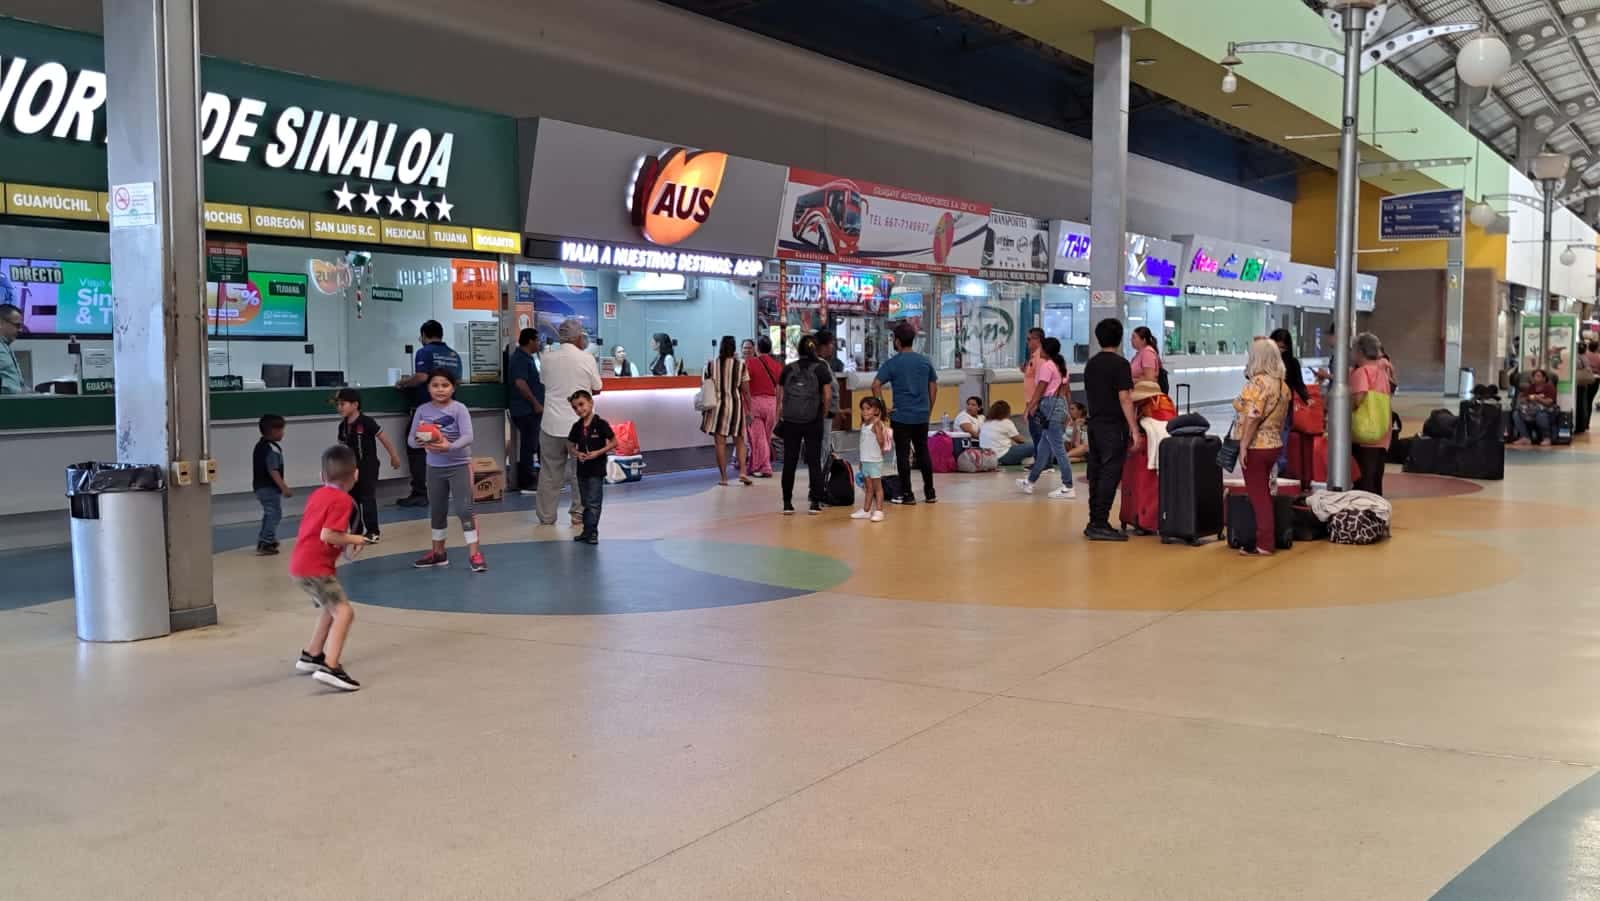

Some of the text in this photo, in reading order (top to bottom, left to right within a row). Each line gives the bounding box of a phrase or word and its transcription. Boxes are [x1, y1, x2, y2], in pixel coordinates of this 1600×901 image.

[201, 91, 267, 162] DE
[264, 105, 454, 188] SINALOA
[13, 192, 92, 212] GUAMÚCHIL
[652, 182, 714, 224] AUS
[255, 214, 305, 231] OBREGÓN
[315, 220, 376, 237] SAN LUIS R.C.
[869, 213, 881, 226] TEL
[385, 226, 426, 240] MEXICALI
[433, 231, 468, 244] TIJUANA
[561, 241, 599, 265] VIAJA
[600, 245, 611, 265] A
[613, 247, 676, 270] NUESTROS
[11, 265, 62, 283] DIRECTO
[76, 307, 92, 325] &
